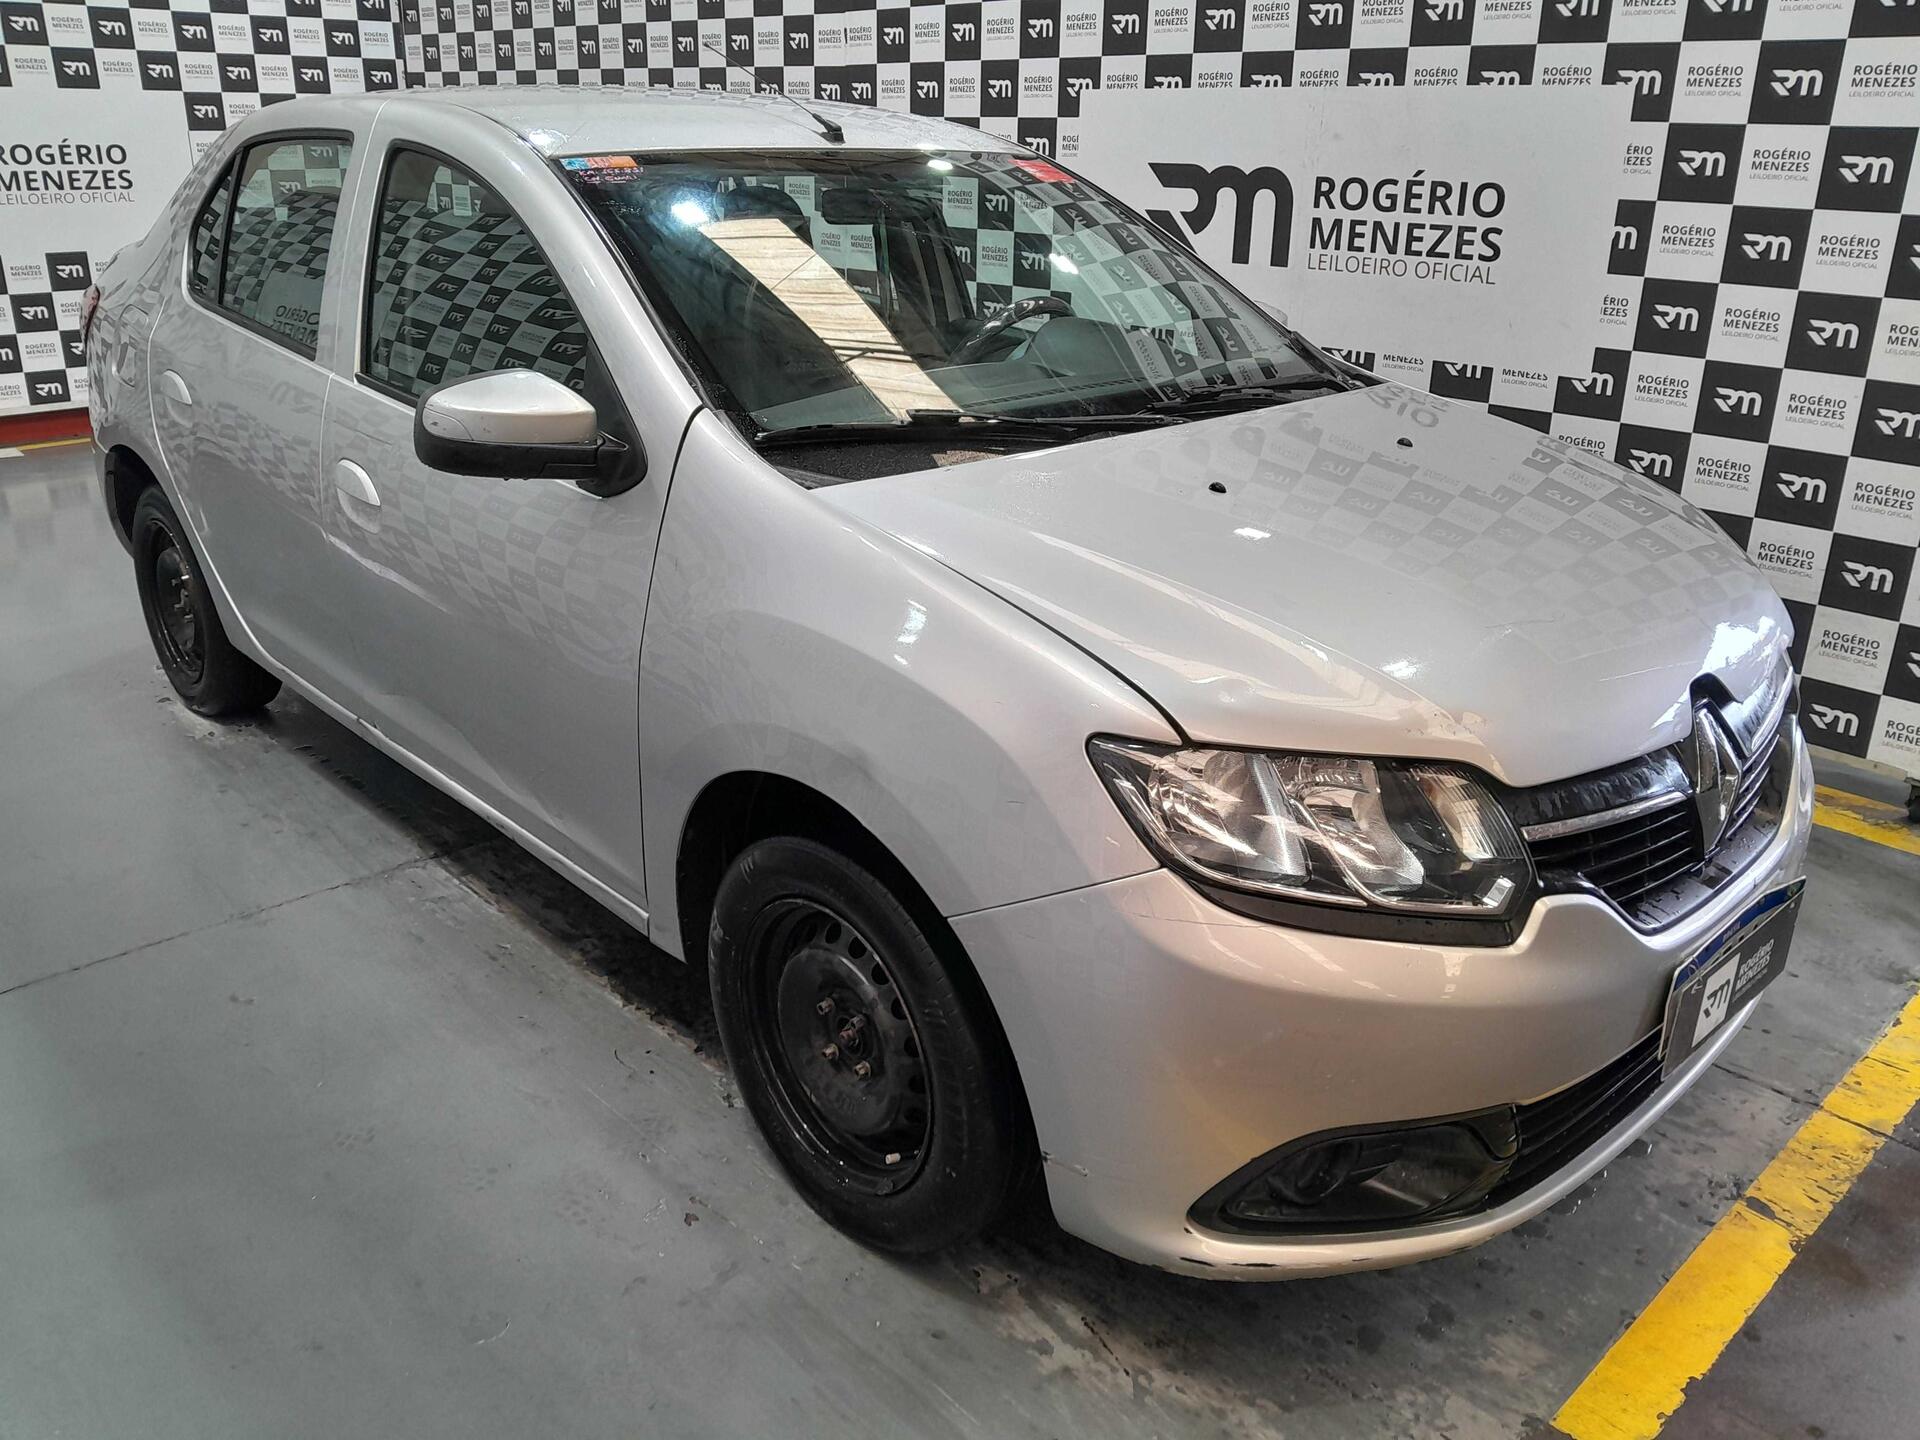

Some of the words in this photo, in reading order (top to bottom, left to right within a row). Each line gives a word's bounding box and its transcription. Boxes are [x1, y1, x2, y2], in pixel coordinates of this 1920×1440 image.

[1155, 6, 1188, 16] ROGÉRIO
[1253, 0, 1290, 11] ROGÉRIO
[1484, 1, 1531, 12] MENEZES
[1067, 11, 1097, 21] ROGÉRIO
[1252, 12, 1290, 22] MENEZES
[1361, 7, 1403, 17] MENEZES
[914, 21, 939, 30] ROGÉRIO
[987, 16, 1014, 25] ROGÉRIO
[1067, 22, 1096, 30] MENEZES
[1155, 17, 1188, 26] MENEZES
[914, 30, 939, 38] MENEZES
[987, 26, 1014, 34] MENEZES
[1301, 68, 1339, 78] ROGÉRIO
[1414, 66, 1458, 77] ROGÉRIO
[1542, 64, 1592, 76] ROGÉRIO
[1687, 63, 1744, 75] ROGÉRIO
[1853, 62, 1918, 75] ROGÉRIO
[949, 76, 975, 84] ROGÉRIO
[1025, 74, 1053, 83] ROGÉRIO
[1108, 72, 1138, 81] ROGÉRIO
[1199, 70, 1233, 80] ROGÉRIO
[1024, 84, 1052, 92] MENEZES
[1685, 78, 1742, 88] MENEZES
[1850, 78, 1916, 88] MENEZES
[1753, 147, 1812, 160] ROGÉRIO
[1750, 160, 1810, 172] MENEZES
[0, 170, 134, 191] MENEZES
[80, 192, 135, 204] OFICIAL
[1313, 169, 1506, 218] ROGÉRIO
[1662, 224, 1716, 236] ROGÉRIO
[1309, 217, 1503, 262] MENEZES
[1660, 236, 1714, 248] MENEZES
[1820, 234, 1882, 248] ROGÉRIO
[1818, 246, 1880, 260] MENEZES
[1307, 252, 1407, 277] LEILOEIRO
[1414, 258, 1496, 285] OFICIAL
[1724, 308, 1781, 321] ROGÉRIO
[1722, 318, 1779, 333] MENEZES
[1638, 374, 1689, 388] ROGÉRIO
[1636, 384, 1688, 399] MENEZES
[1789, 393, 1848, 409] ROGÉRIO
[1786, 404, 1846, 421] MENEZES
[1697, 456, 1751, 472] ROGÉRIO
[1695, 466, 1750, 484] MENEZES
[1855, 481, 1917, 499] ROGÉRIO
[1852, 492, 1914, 511] MENEZES
[1759, 541, 1815, 559] ROGÉRIO
[1757, 551, 1813, 571] MENEZES
[1822, 629, 1881, 649] ROGÉRIO
[1820, 639, 1879, 661] MENEZES
